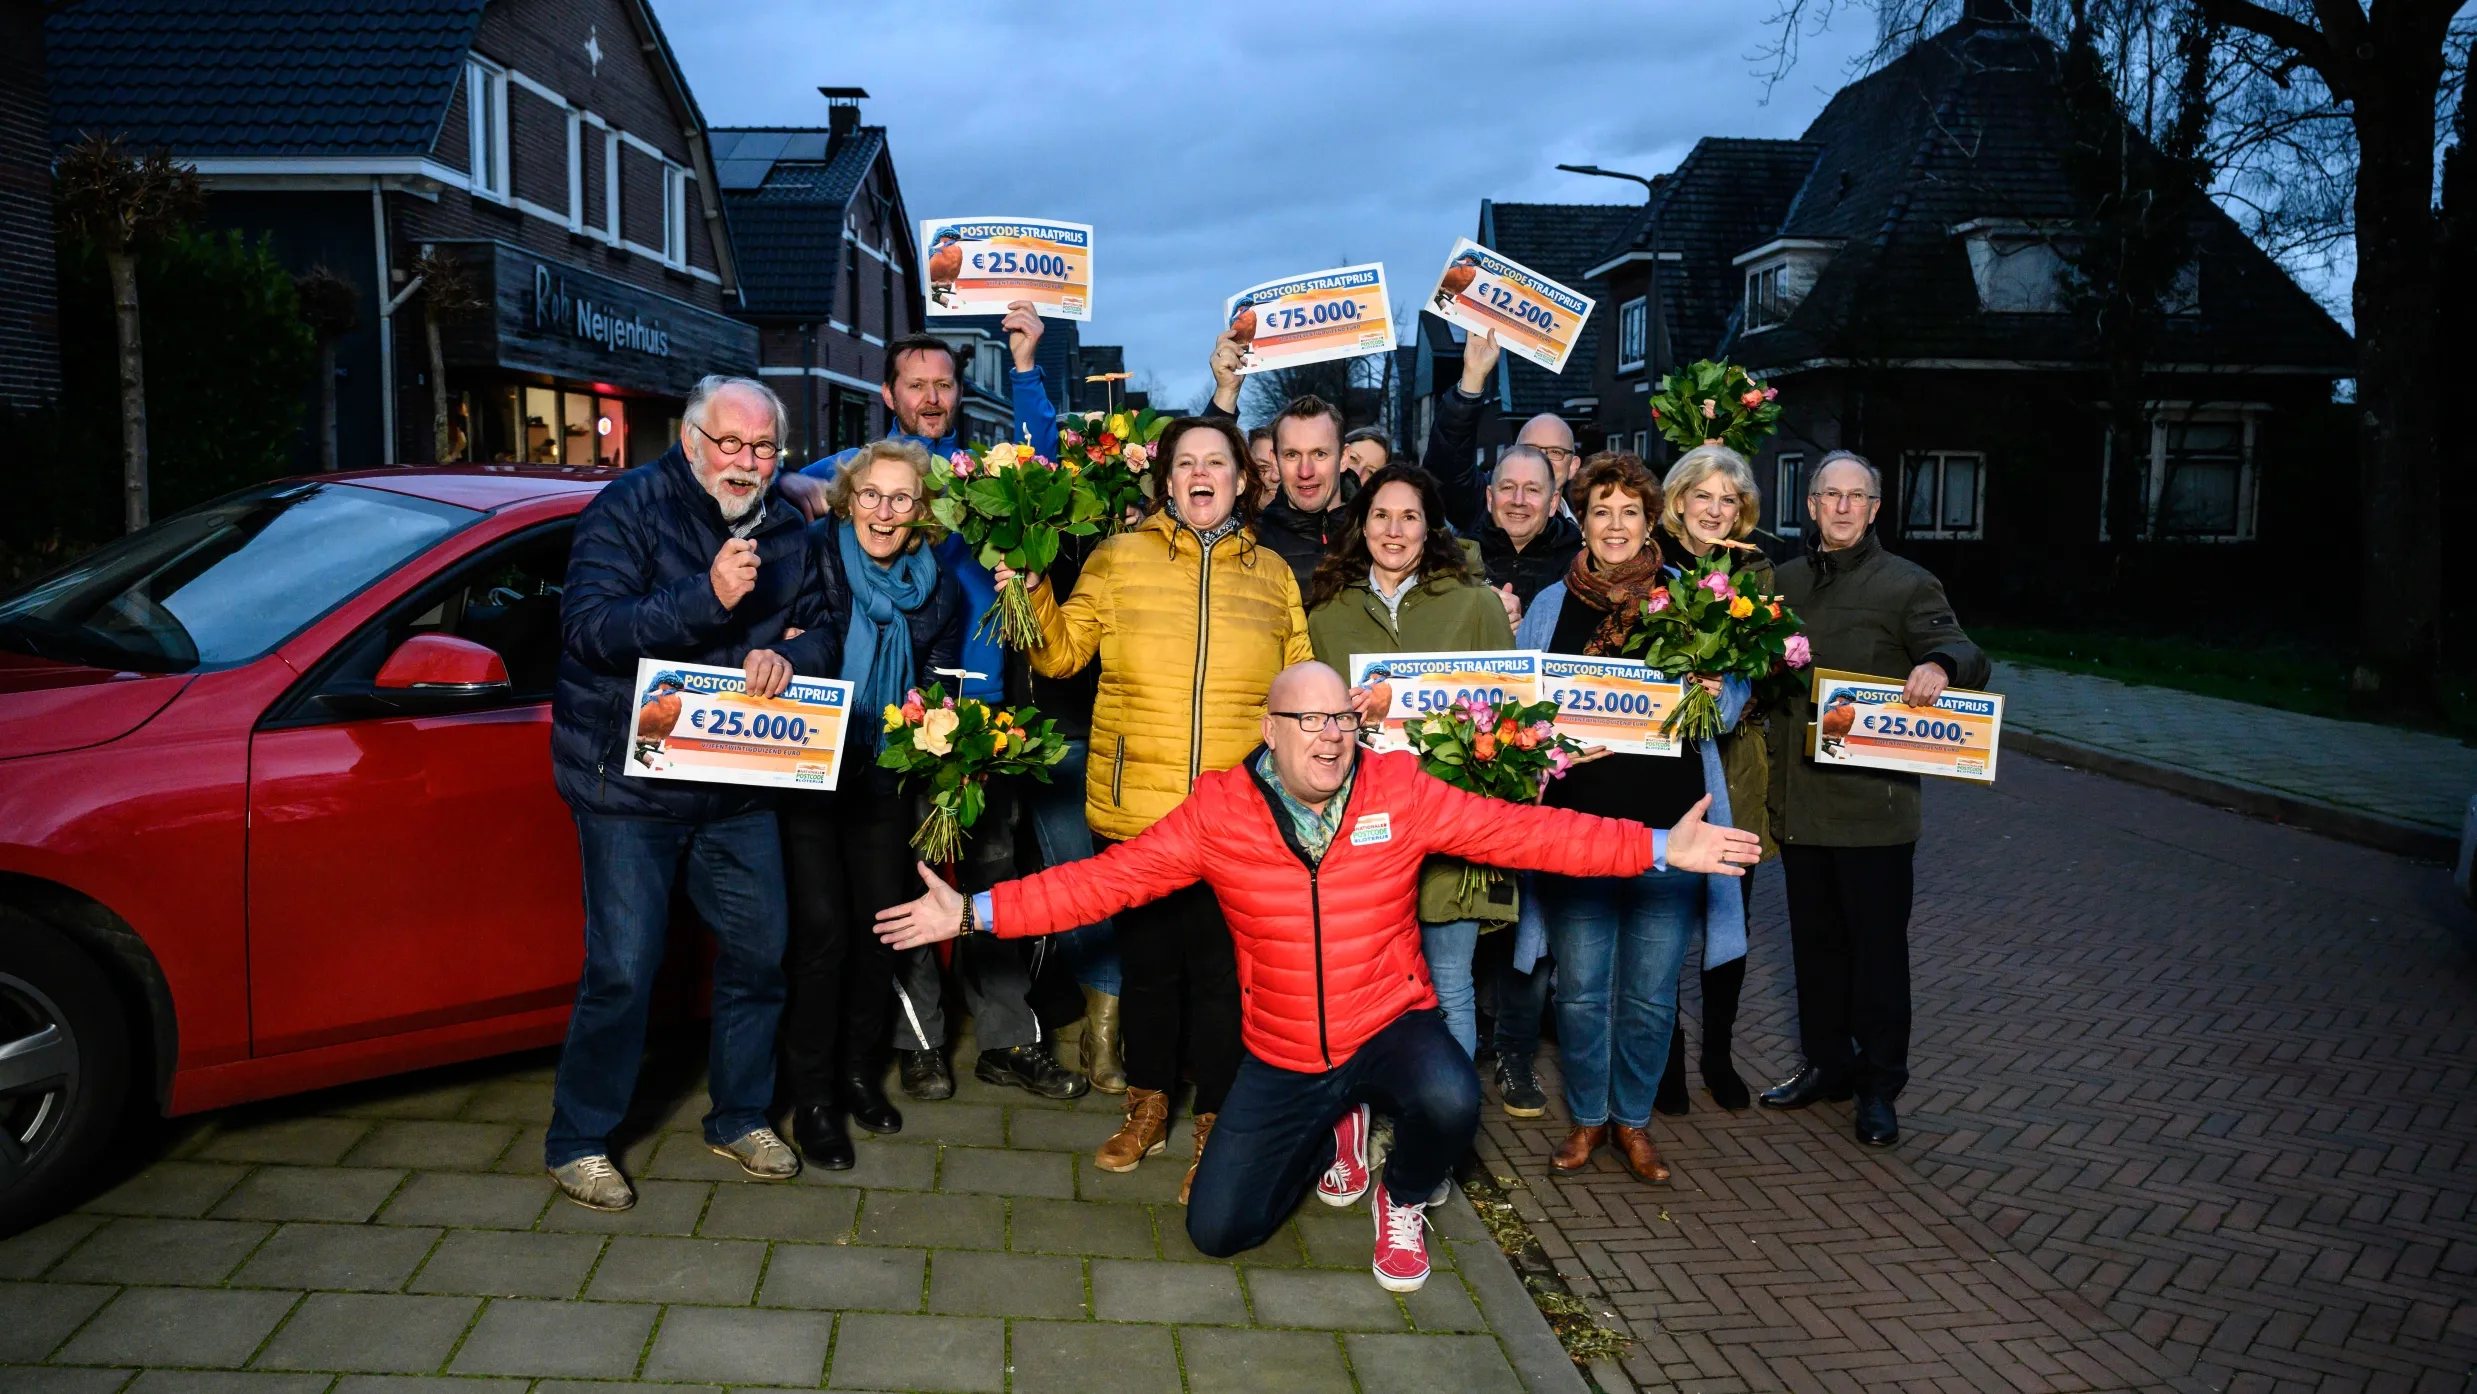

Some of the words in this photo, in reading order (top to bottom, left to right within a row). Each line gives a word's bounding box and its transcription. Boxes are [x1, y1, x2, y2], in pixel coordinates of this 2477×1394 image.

[535, 264, 571, 328] Rob
[577, 298, 670, 357] Neijenhuis
[1604, 666, 1664, 681] STRAATPRI
[684, 674, 746, 693] POSTCOD
[781, 685, 838, 702] AATPRIJS
[1856, 690, 1904, 703] POSTCO
[1933, 698, 1988, 712] AATPRIJS
